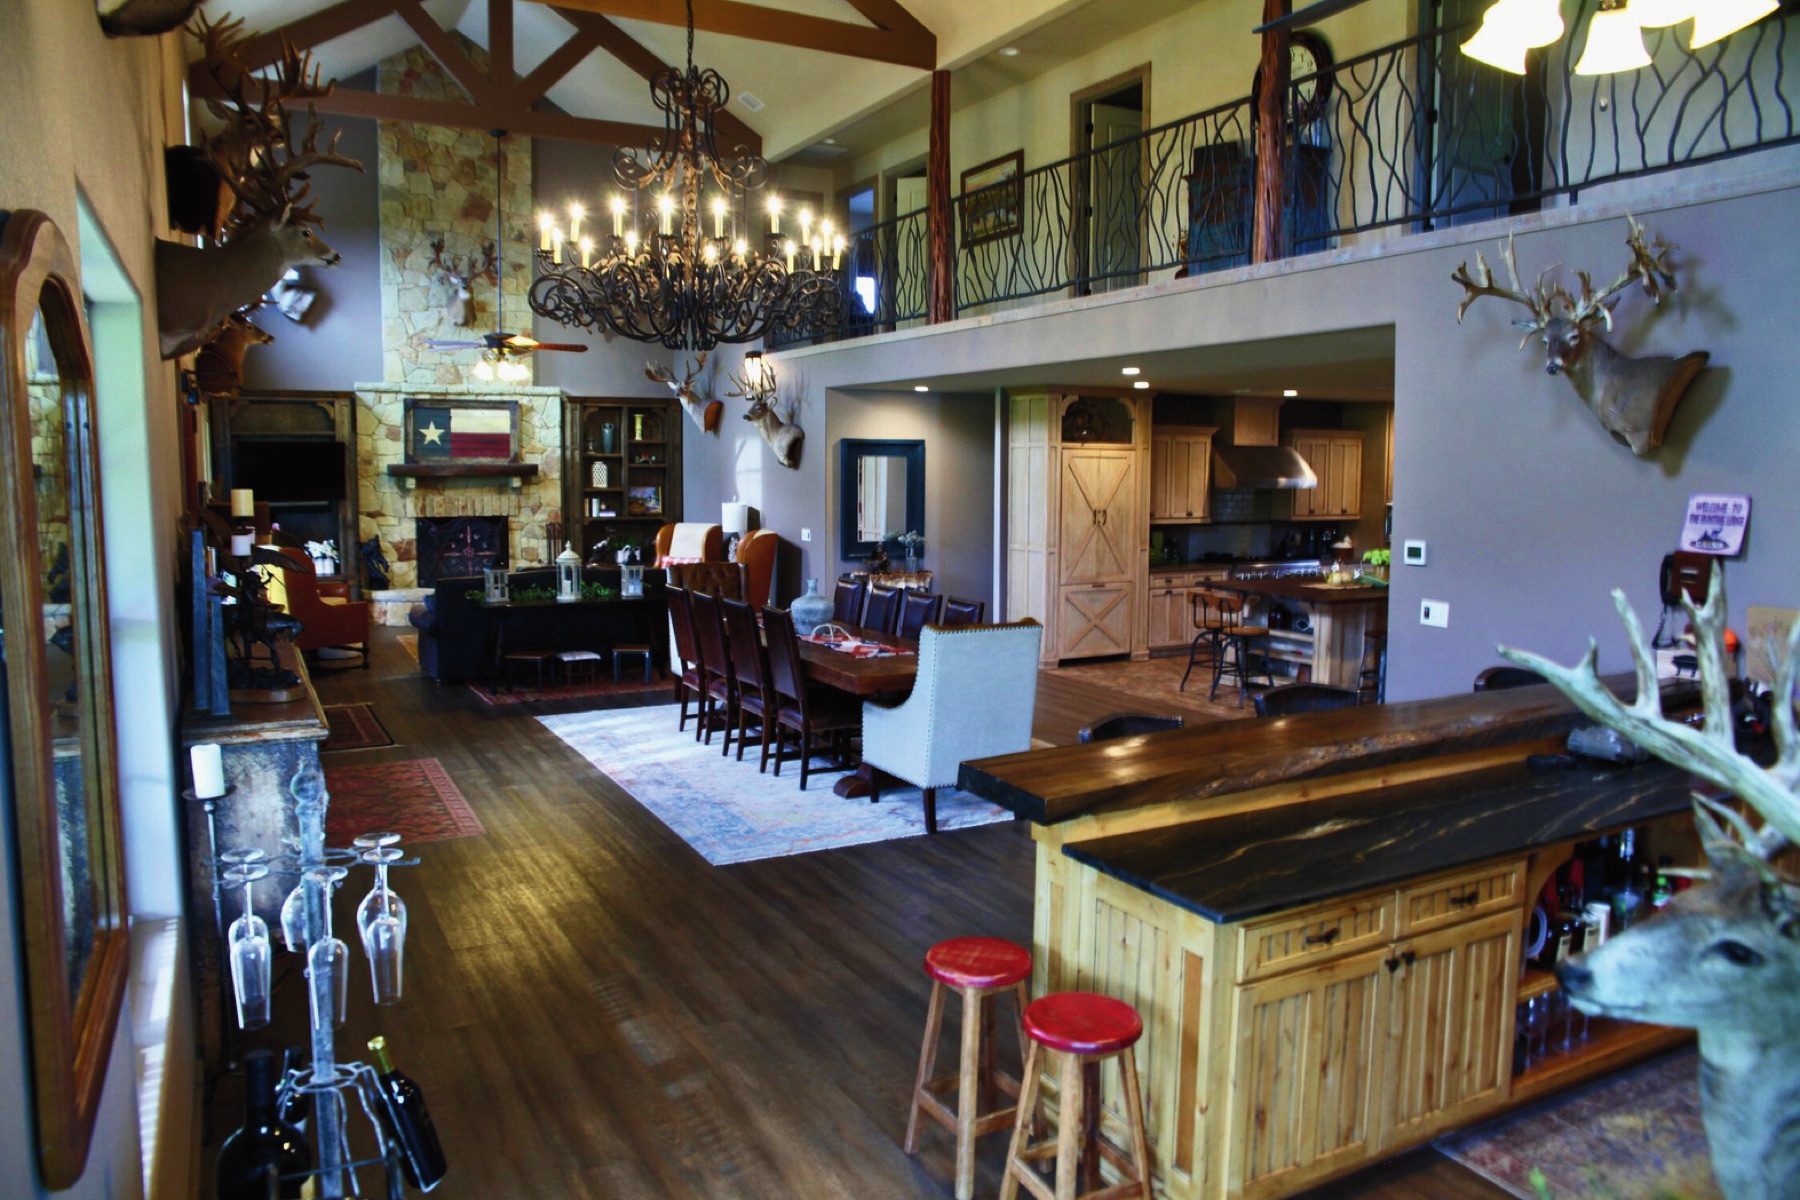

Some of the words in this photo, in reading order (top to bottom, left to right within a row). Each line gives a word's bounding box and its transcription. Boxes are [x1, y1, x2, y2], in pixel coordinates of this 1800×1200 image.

[1696, 502, 1727, 514] WELCOME
[1733, 503, 1742, 514] TO
[1689, 514, 1699, 525] THE
